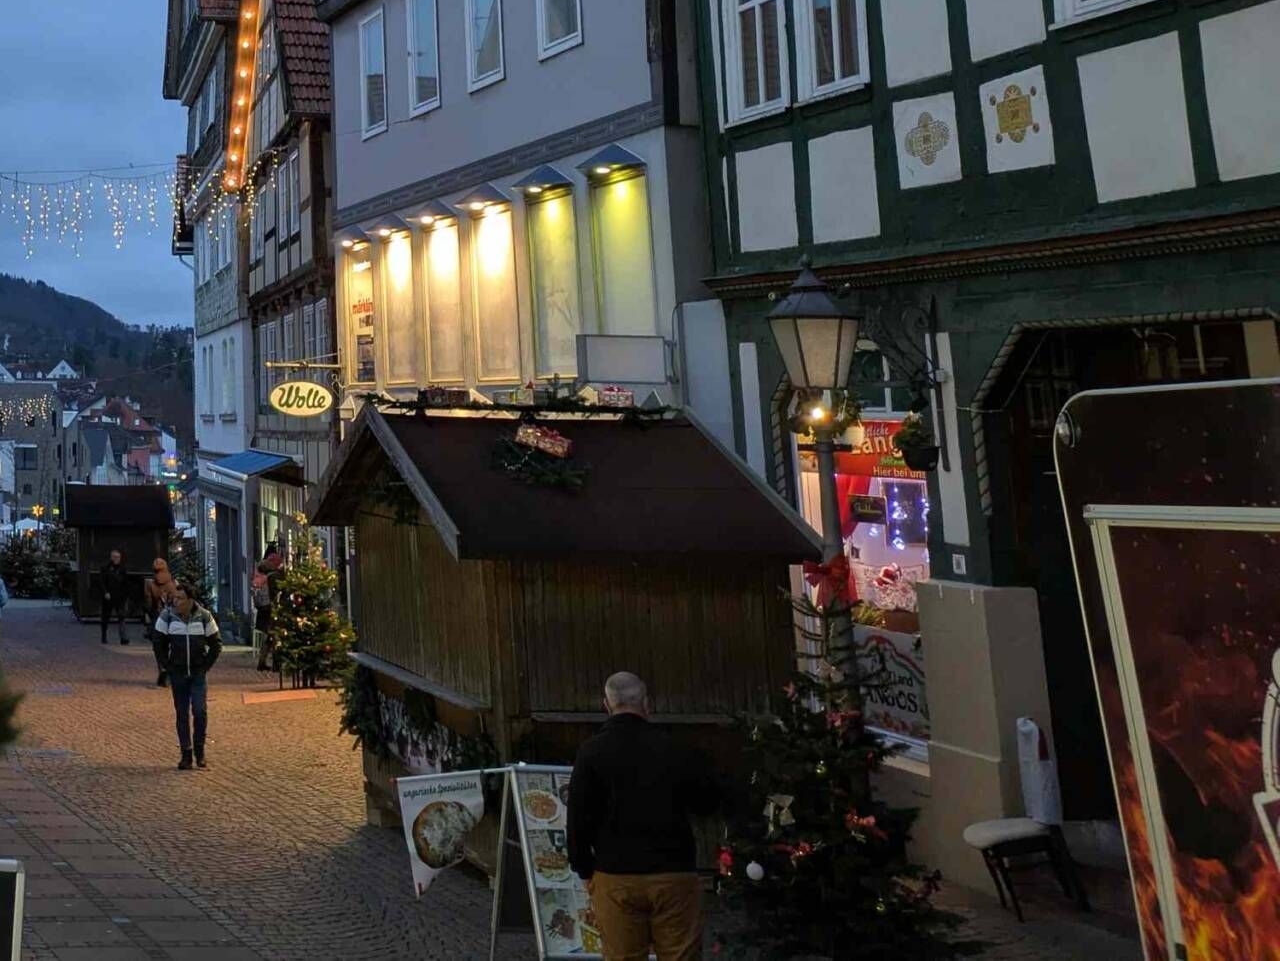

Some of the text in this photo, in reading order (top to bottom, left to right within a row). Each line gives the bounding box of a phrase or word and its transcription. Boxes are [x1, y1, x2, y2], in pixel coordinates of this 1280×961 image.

[278, 385, 326, 409] Wolle
[873, 465, 926, 479] Hier bei uns
